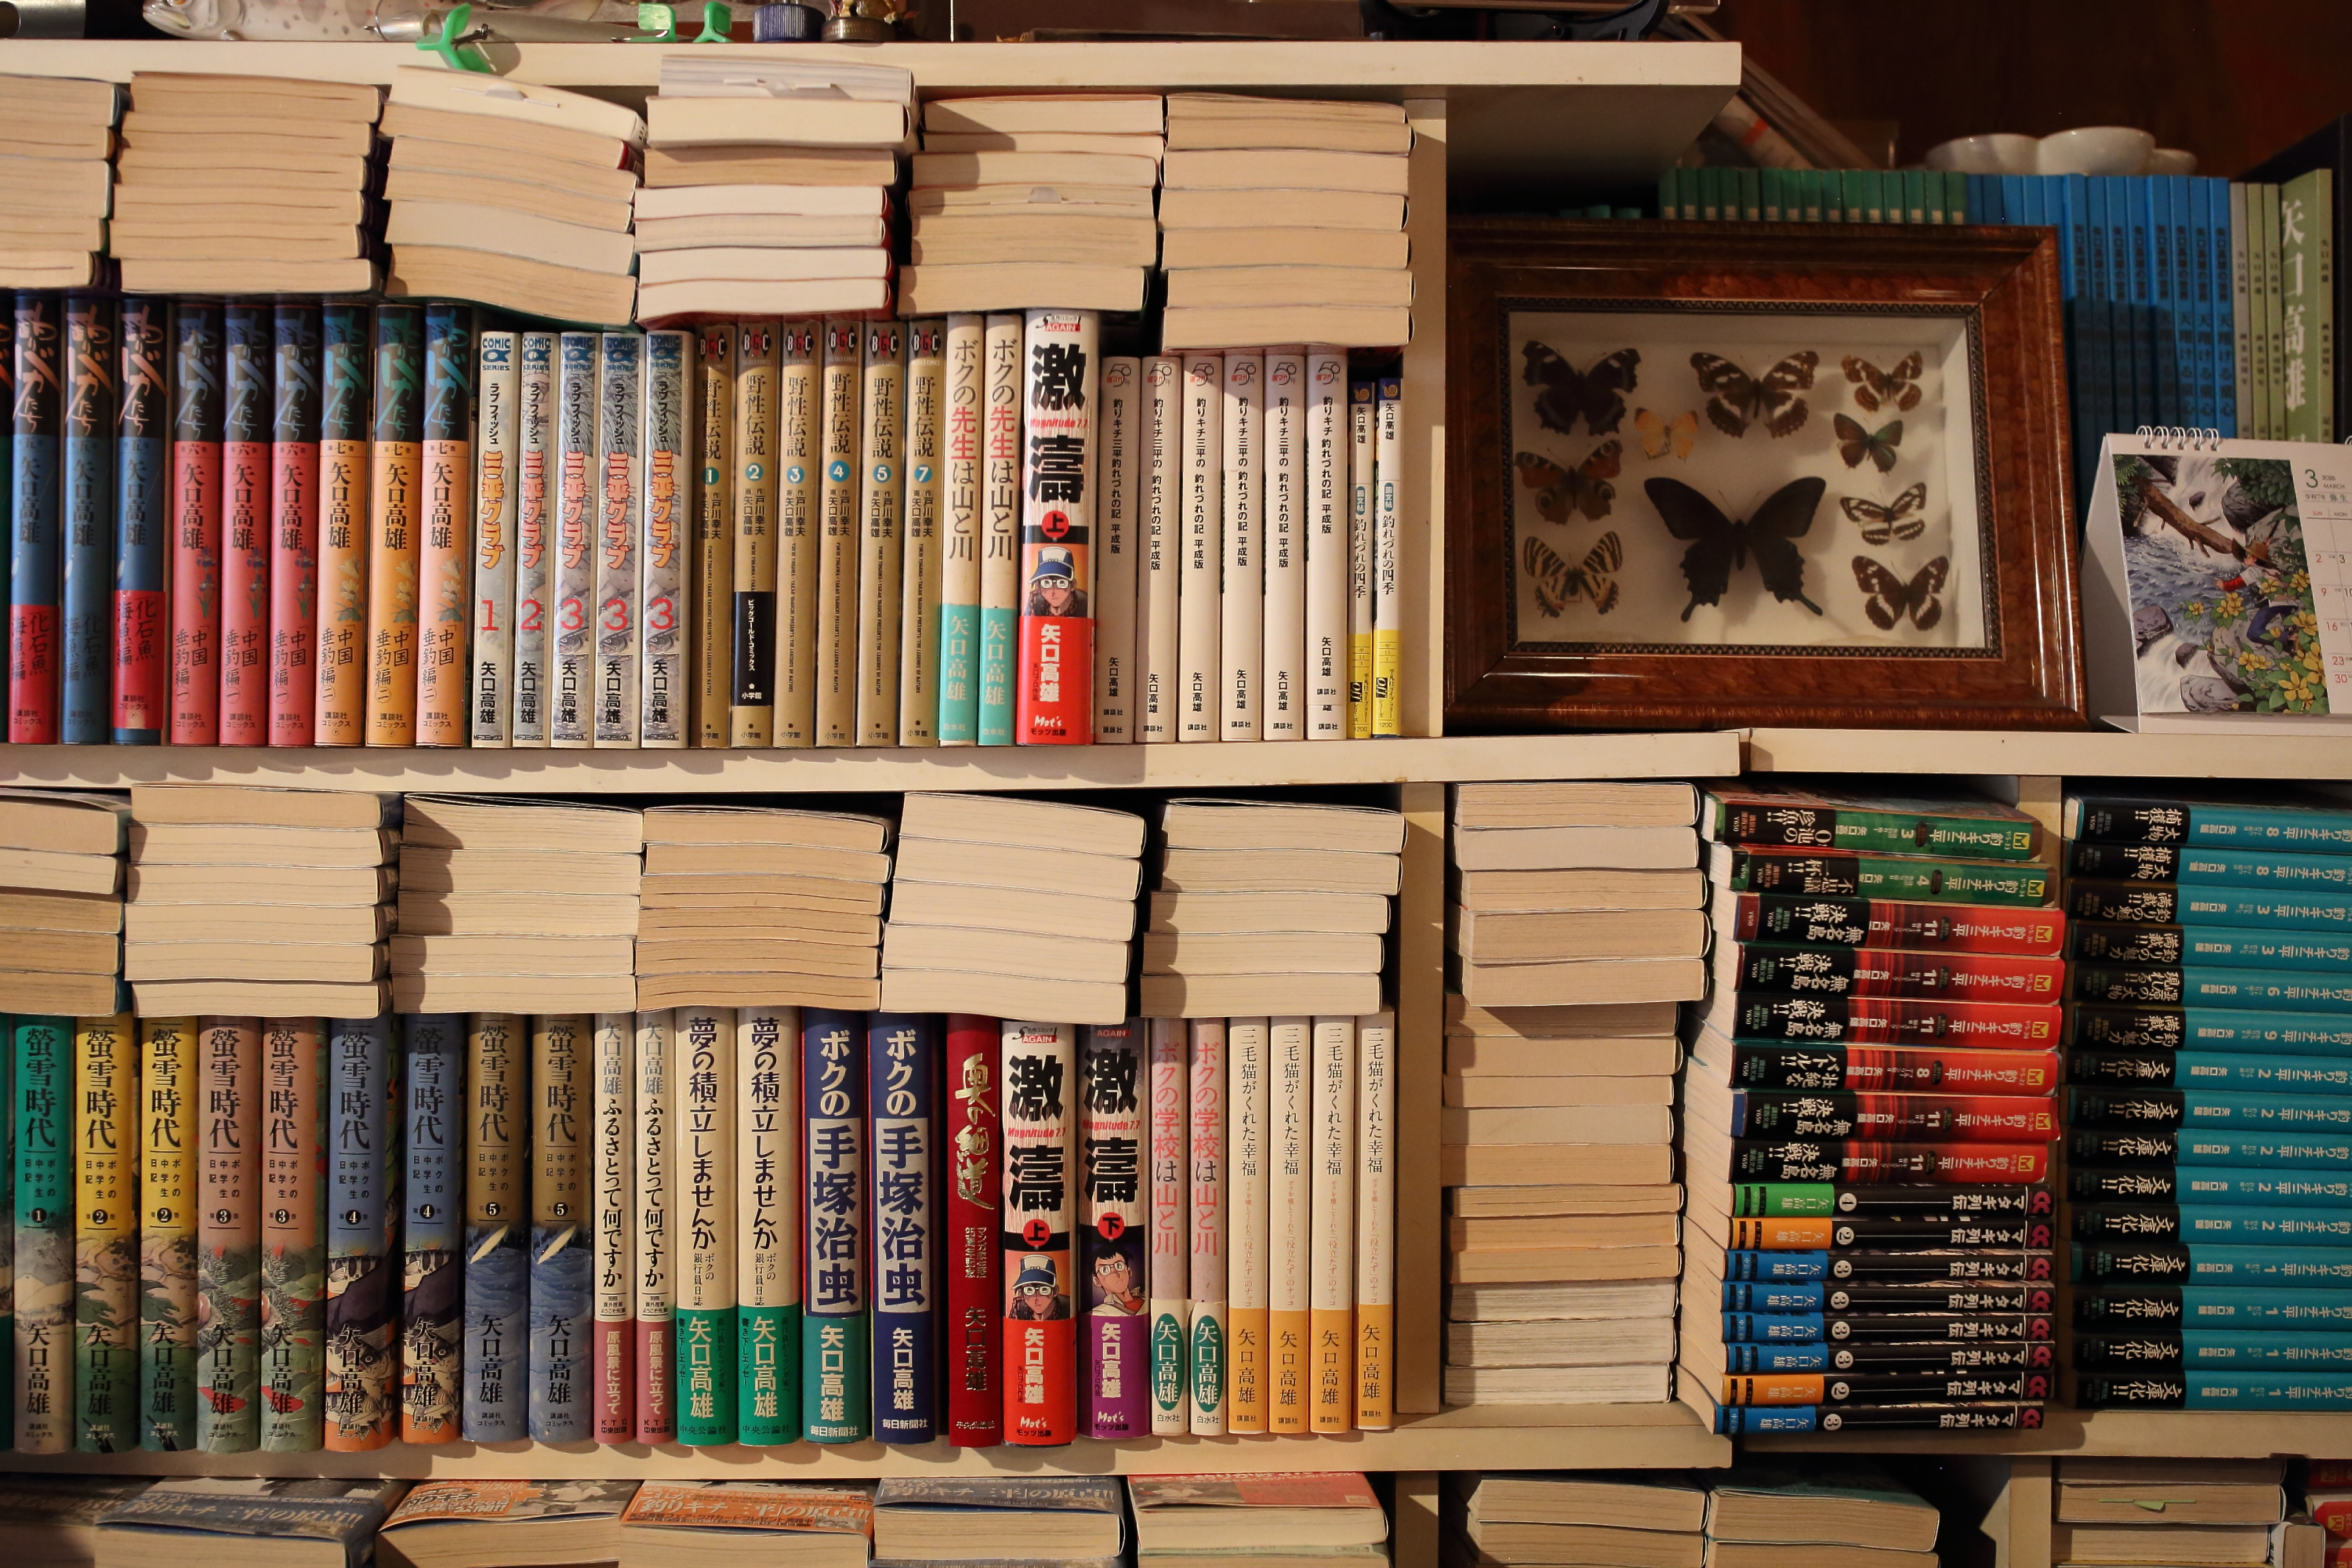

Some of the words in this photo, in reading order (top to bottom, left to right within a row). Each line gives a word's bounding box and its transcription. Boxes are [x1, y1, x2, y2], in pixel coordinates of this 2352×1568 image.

[481, 338, 510, 348] COMIC
[743, 336, 770, 350] BGC
[830, 333, 855, 347] BGC
[913, 335, 938, 350] BGC
[745, 375, 766, 456] 野性伝説
[787, 376, 807, 457] 野性伝説
[831, 373, 851, 454] 野性伝説
[873, 377, 892, 459] 野性伝説
[914, 376, 935, 457] 野性伝説
[1238, 398, 1248, 466] 釣りキチ三平の
[949, 339, 978, 561] ボクの先生は山と川
[987, 339, 1017, 561] ボクの先生は山と川
[1152, 399, 1163, 468] 釣りキチ三平の
[1321, 438, 1332, 499] 釣れづれの記
[2305, 469, 2318, 488] 3
[481, 451, 505, 569] 三平クラブ
[521, 451, 545, 569] 三平クラブ
[562, 451, 586, 569] 三平クラブ
[605, 451, 629, 570] 三平クラブ
[650, 450, 675, 569] 三平クラブ
[755, 495, 765, 535] 戸川幸夫
[924, 497, 933, 537] 戸川幸夫
[1151, 475, 1162, 535] 釣れづれの記
[1238, 471, 1248, 532] 釣れづれの記
[1321, 504, 1331, 533] 平成版
[1047, 515, 1064, 532] 上
[1150, 541, 1161, 570] 平成版
[1237, 538, 1247, 567] 平成版
[1353, 518, 1367, 598] 釣れづれの四季
[1381, 515, 1396, 595] 釣れづれの四季
[2315, 554, 2321, 563] 2
[2339, 554, 2345, 563] 3
[481, 601, 499, 630] 1
[520, 599, 542, 630] 2
[561, 599, 583, 630] 3
[604, 599, 628, 630] 3
[650, 599, 673, 630] 3
[2327, 622, 2338, 630] 16
[1322, 637, 1332, 677] 矢口高雄
[480, 662, 496, 724] 矢口高雄
[521, 662, 536, 724] 矢口高雄
[562, 662, 577, 724] 矢口高雄
[606, 662, 621, 724] 矢口高雄
[652, 662, 668, 724] 矢口高雄
[1148, 673, 1159, 713] 矢口高雄
[1236, 670, 1247, 709] 矢口高雄
[2335, 674, 2347, 683] 30
[1930, 829, 2003, 847] 釣りキチ三平
[1918, 875, 1929, 886] 4
[1944, 877, 2018, 893] 釣りキチ三平
[2256, 866, 2269, 876] 8
[2273, 866, 2346, 882] 釣りキチ三平
[1922, 920, 1938, 937] 11
[1952, 921, 2026, 940] 釣りキチ三平
[2274, 905, 2346, 920] 釣りキチ三平
[1807, 925, 1864, 943] 無名島
[2267, 987, 2280, 996] 6
[1917, 1068, 1929, 1078] 8
[1944, 1062, 2017, 1082] 釣りキチ三平
[1241, 1029, 1257, 1176] 三毛猫がくれた幸福
[1283, 1028, 1300, 1175] 三毛猫がくれた幸福
[1327, 1028, 1343, 1175] 三毛猫がくれた幸福
[1367, 1026, 1383, 1174] 三毛猫がくれた幸福
[690, 1017, 717, 1249] 夢の積立しませんか
[751, 1017, 779, 1249] 夢の積立しませんか
[1007, 1127, 1053, 1138] Magnitude
[1154, 1043, 1180, 1256] ボクの学校は山と川
[1194, 1043, 1218, 1256] ボクの学校は山と川
[2260, 1146, 2273, 1155] 2
[2277, 1145, 2349, 1160] 釣りキチ三平
[602, 1098, 622, 1288] ふるさとって何ですか
[644, 1098, 664, 1288] ふるさとって何ですか
[1952, 1195, 2025, 1210] マタギ列伝
[1028, 1221, 1046, 1241] 上
[1102, 1217, 1120, 1237] 下
[693, 1254, 702, 1306] 銀行員日誌
[706, 1254, 714, 1280] ボクの
[1950, 1261, 2023, 1277] マタギ列伝
[1948, 1323, 2023, 1338] マタギ列伝
[607, 1331, 620, 1414] 原風景に立って
[648, 1331, 662, 1414] 原風景に立って
[821, 1326, 844, 1421] 矢口高雄
[892, 1327, 913, 1410] 矢口高雄
[1363, 1325, 1380, 1399] 矢口高雄
[680, 1425, 727, 1435] 中央公論社
[811, 1425, 858, 1437] 毎日新聞社
[883, 1418, 928, 1429] 毎日新聞社
[1196, 1415, 1219, 1425] 白水社
[1940, 1414, 2014, 1428] マタギ列伝
